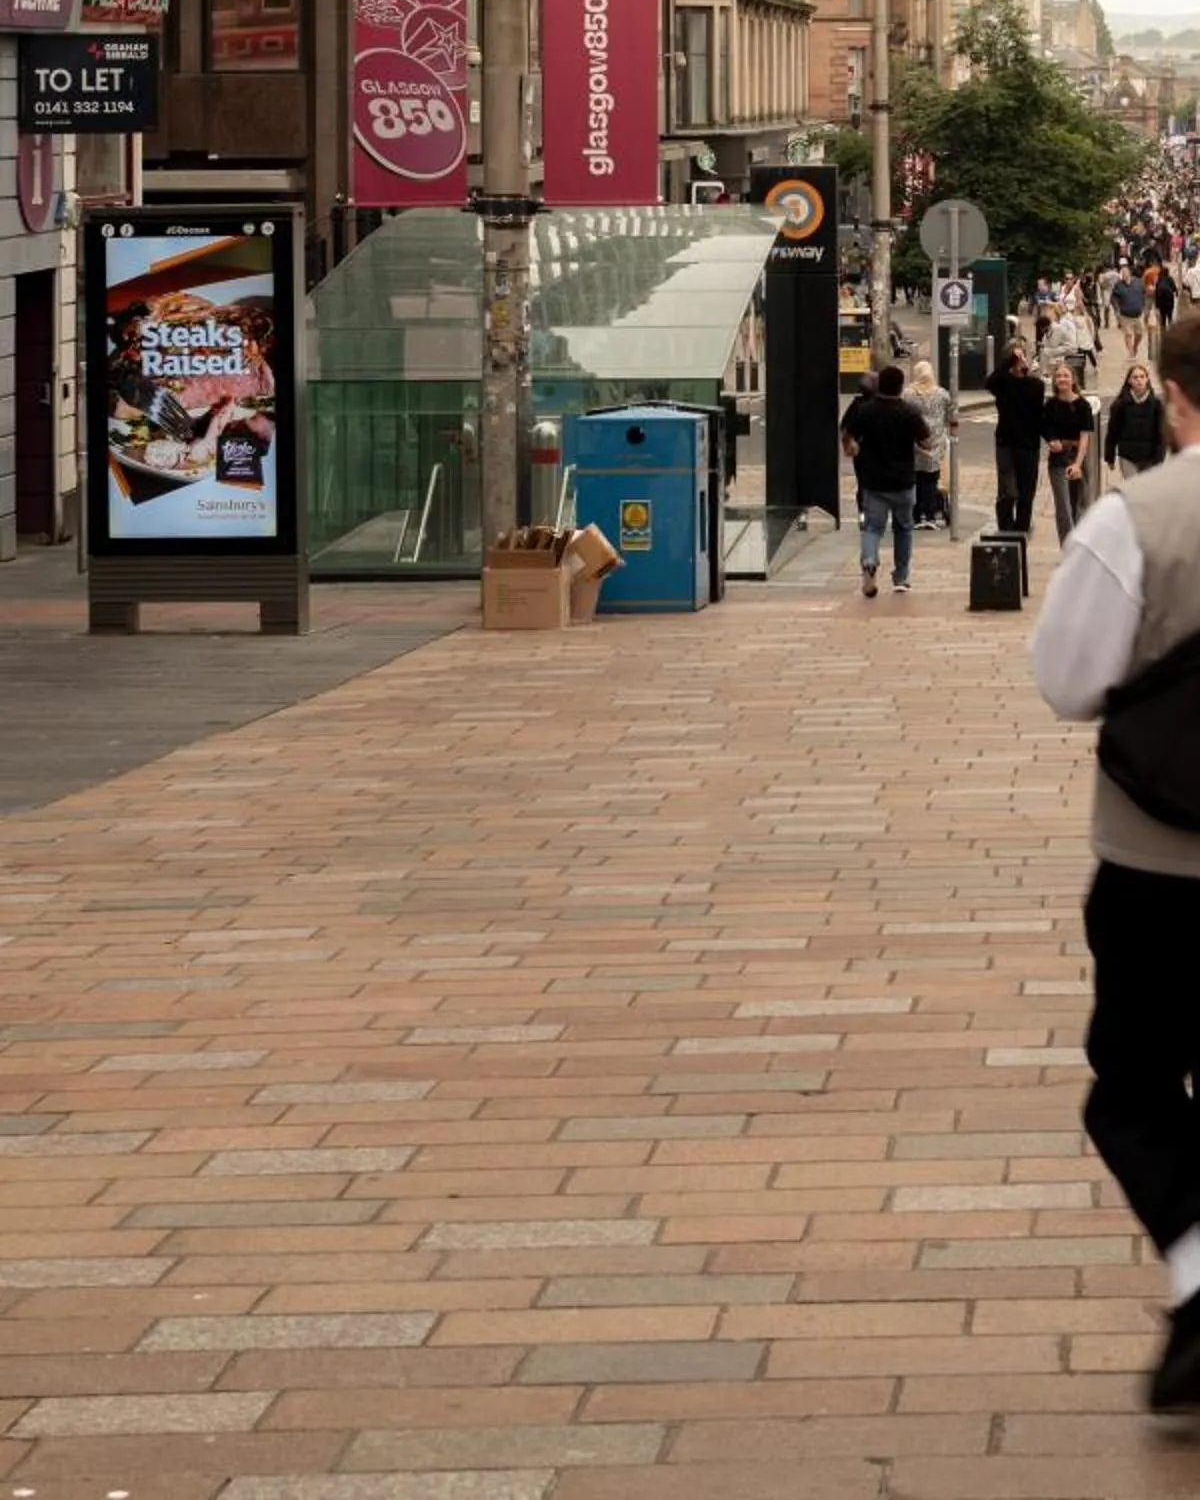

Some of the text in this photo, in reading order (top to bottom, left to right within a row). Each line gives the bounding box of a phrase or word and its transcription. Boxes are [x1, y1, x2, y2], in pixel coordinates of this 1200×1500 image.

[103, 43, 149, 51] GRAHAM
[34, 67, 125, 93] TO LET
[360, 78, 442, 98] GLASGOW
[34, 100, 135, 114] 0141 332 1194
[367, 98, 455, 140] 850
[140, 316, 249, 349] Steaks.
[142, 349, 250, 376] Raised.
